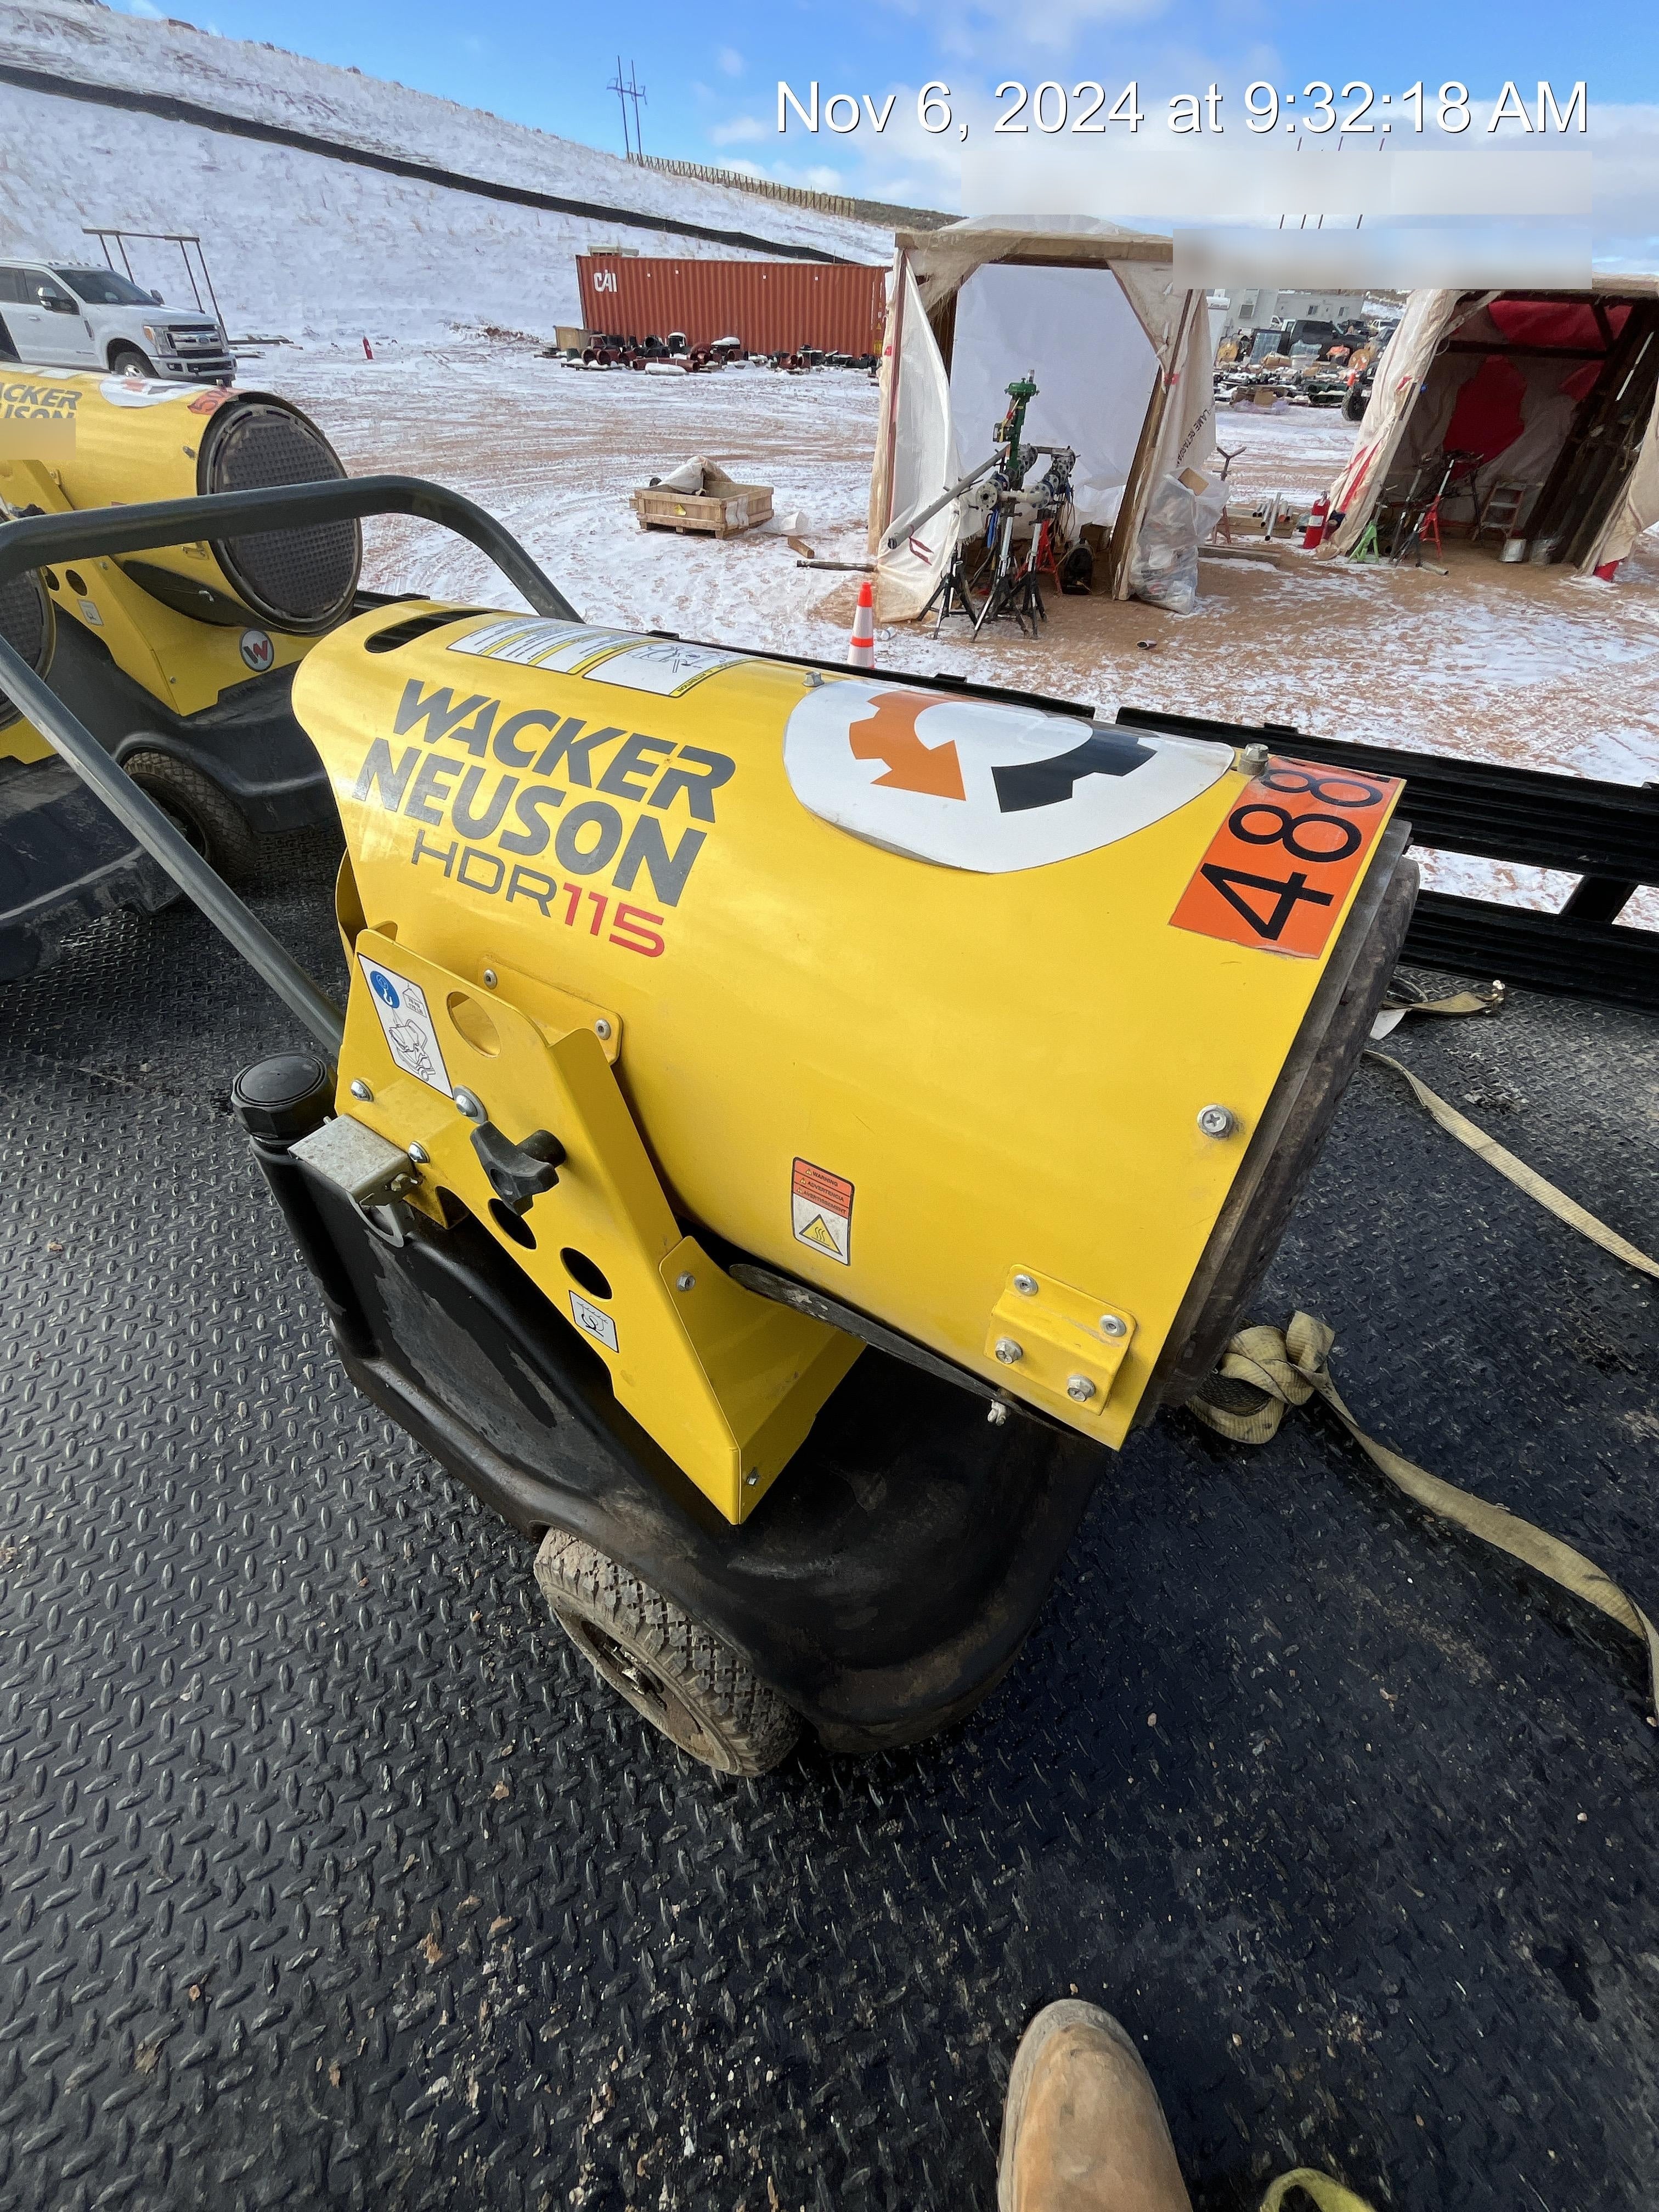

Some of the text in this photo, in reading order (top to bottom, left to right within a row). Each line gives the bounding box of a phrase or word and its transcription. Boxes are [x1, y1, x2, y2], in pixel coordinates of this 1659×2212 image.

[0, 382, 82, 410] CKER
[393, 679, 736, 825] WACKER
[352, 738, 707, 909] NEUSON
[412, 829, 665, 958] HDR115
[807, 1181, 844, 1202] ADVERTENCIA
[812, 1170, 838, 1187] WARNING
